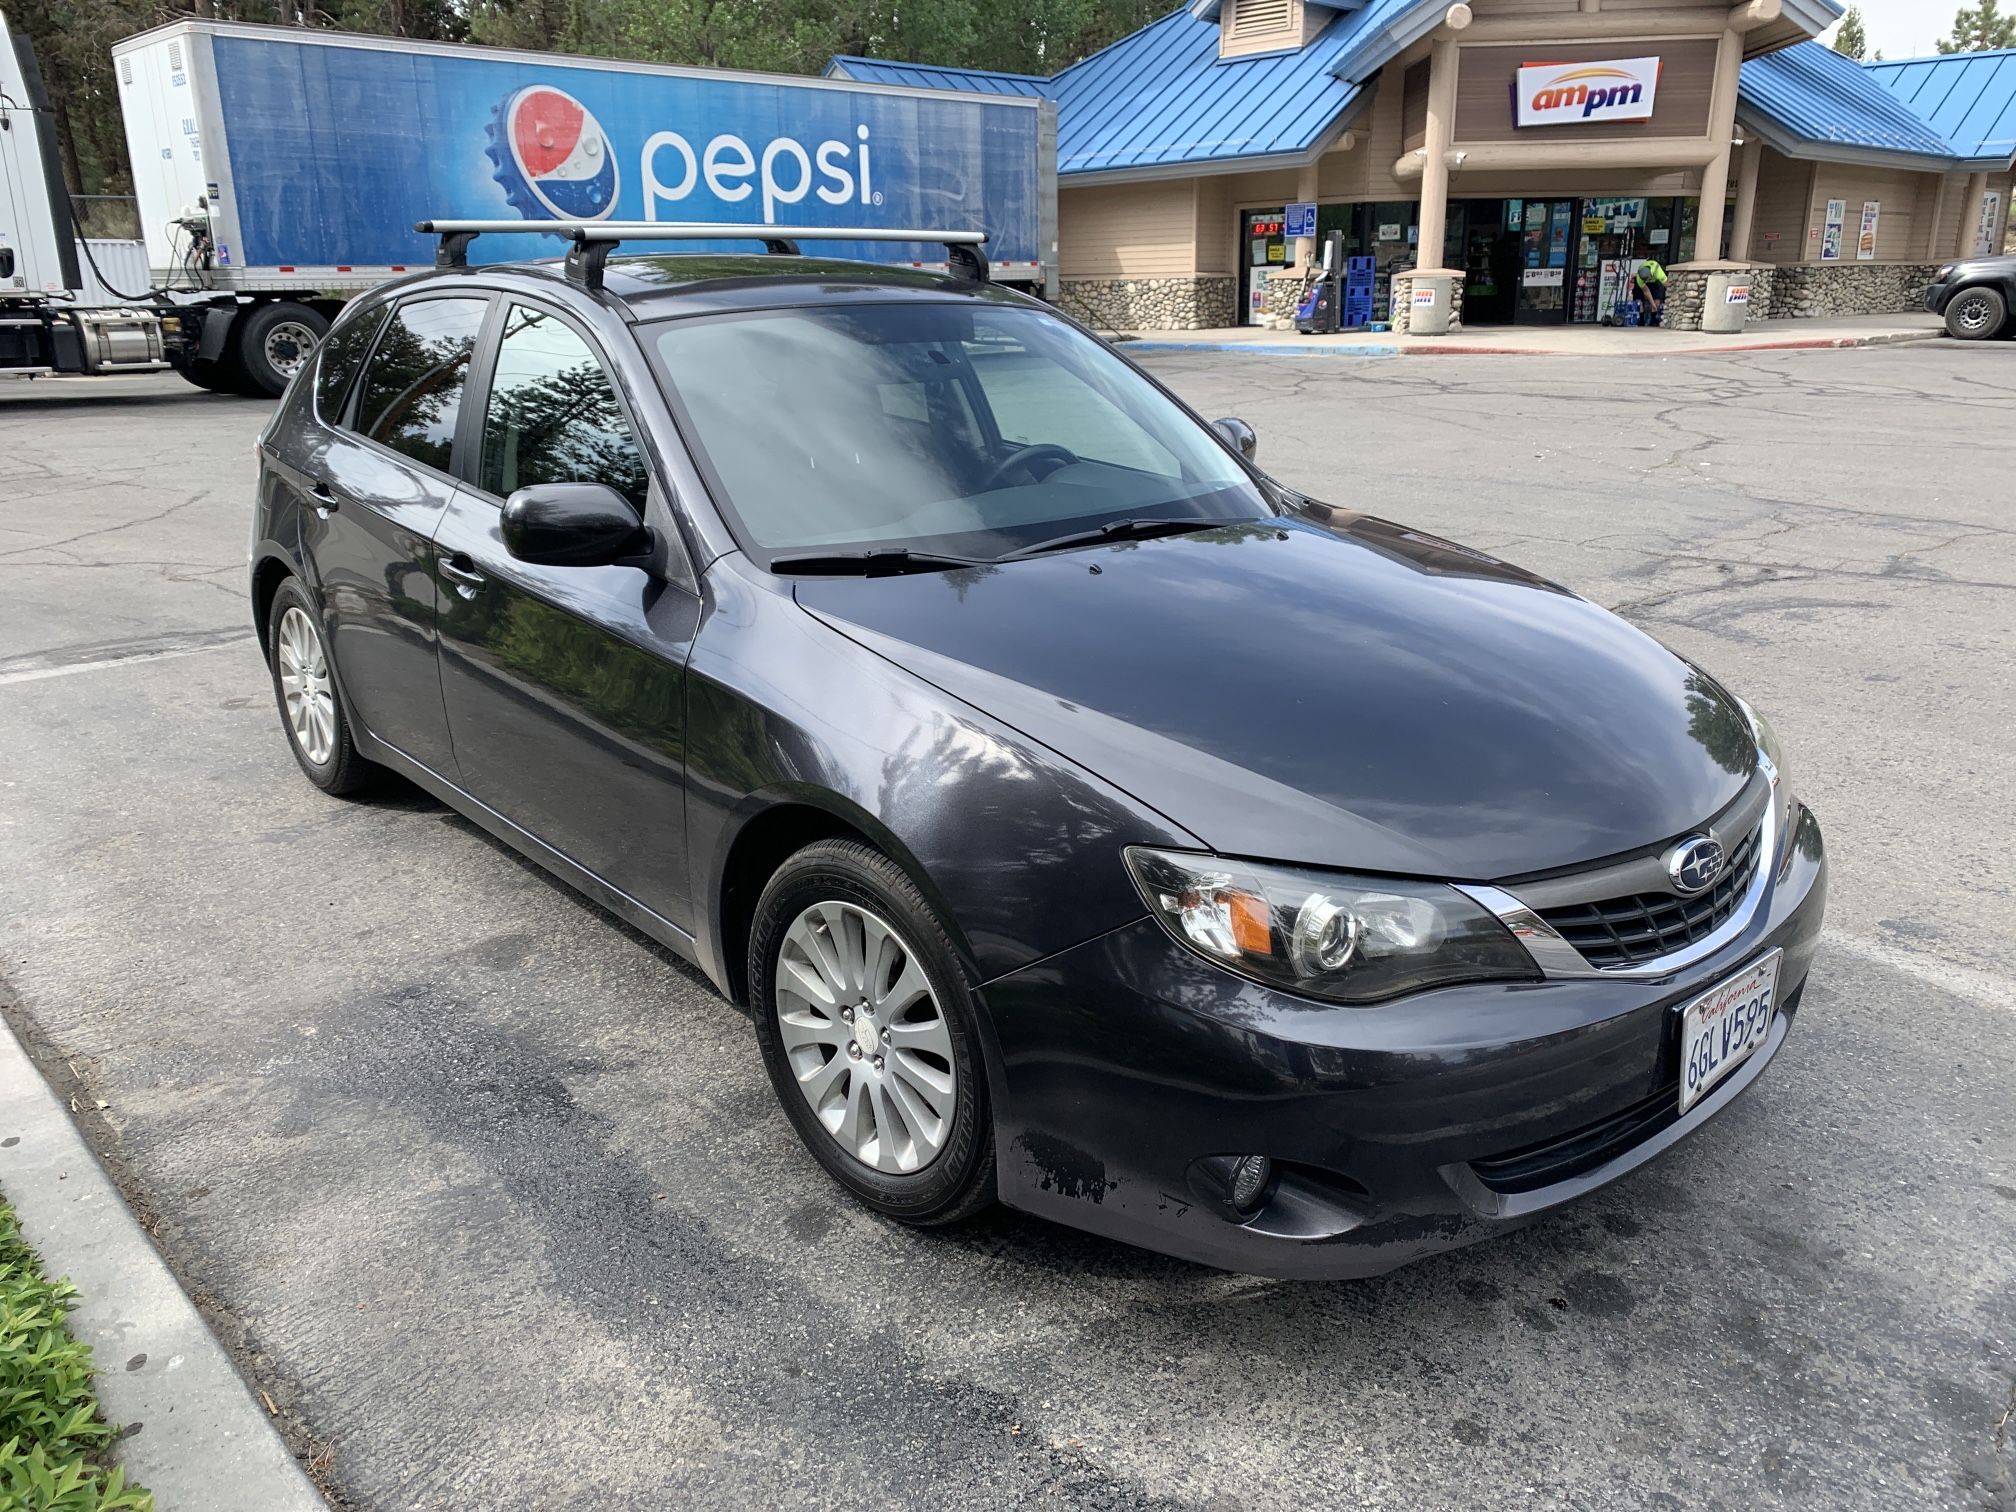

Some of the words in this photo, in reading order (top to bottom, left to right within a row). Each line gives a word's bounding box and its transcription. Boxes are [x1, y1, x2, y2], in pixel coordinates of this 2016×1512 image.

[1532, 82, 1642, 117] ampm
[640, 124, 872, 223] pepsi
[1700, 975, 1762, 1025] California
[1687, 988, 1771, 1090] 6GLV595
